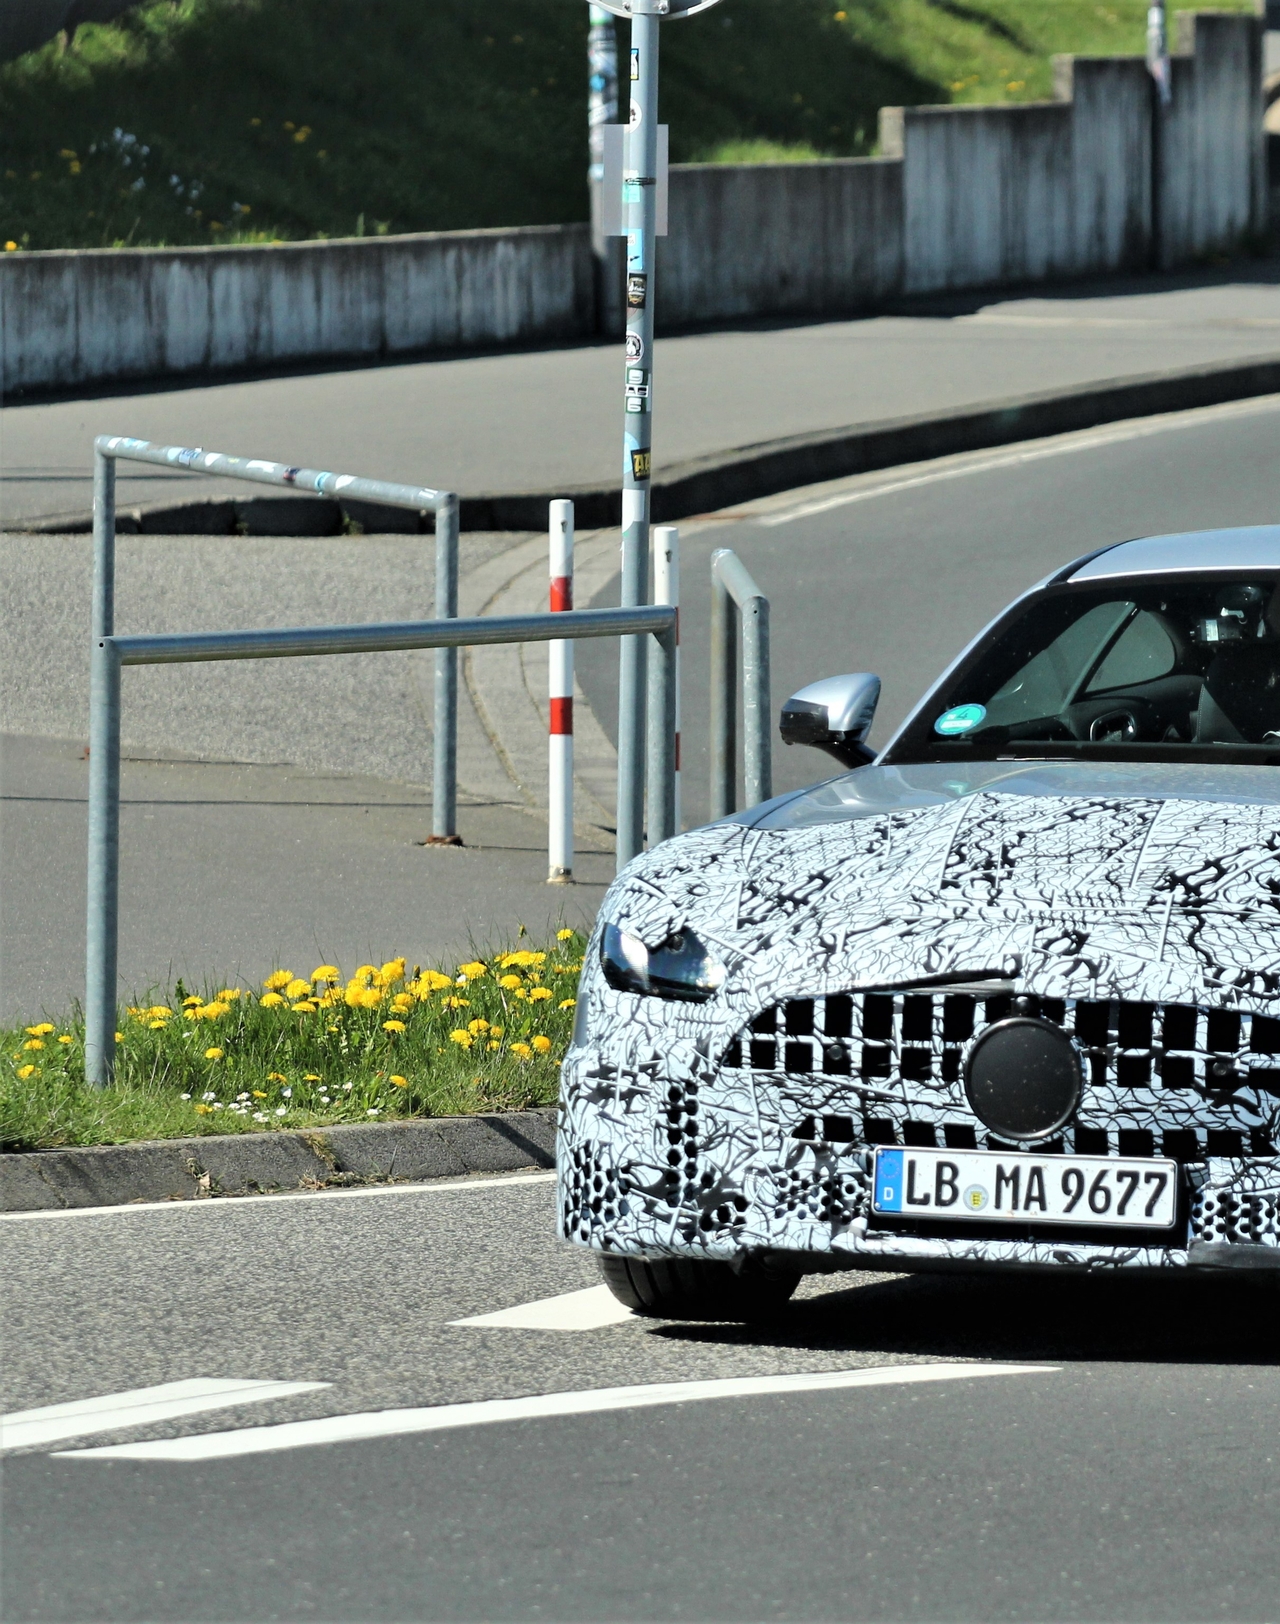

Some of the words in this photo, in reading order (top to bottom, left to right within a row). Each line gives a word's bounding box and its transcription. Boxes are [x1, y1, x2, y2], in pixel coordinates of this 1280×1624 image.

[883, 1186, 894, 1201] D
[906, 1159, 960, 1207] LB
[994, 1163, 1048, 1211] MA
[1061, 1167, 1168, 1217] 9677
